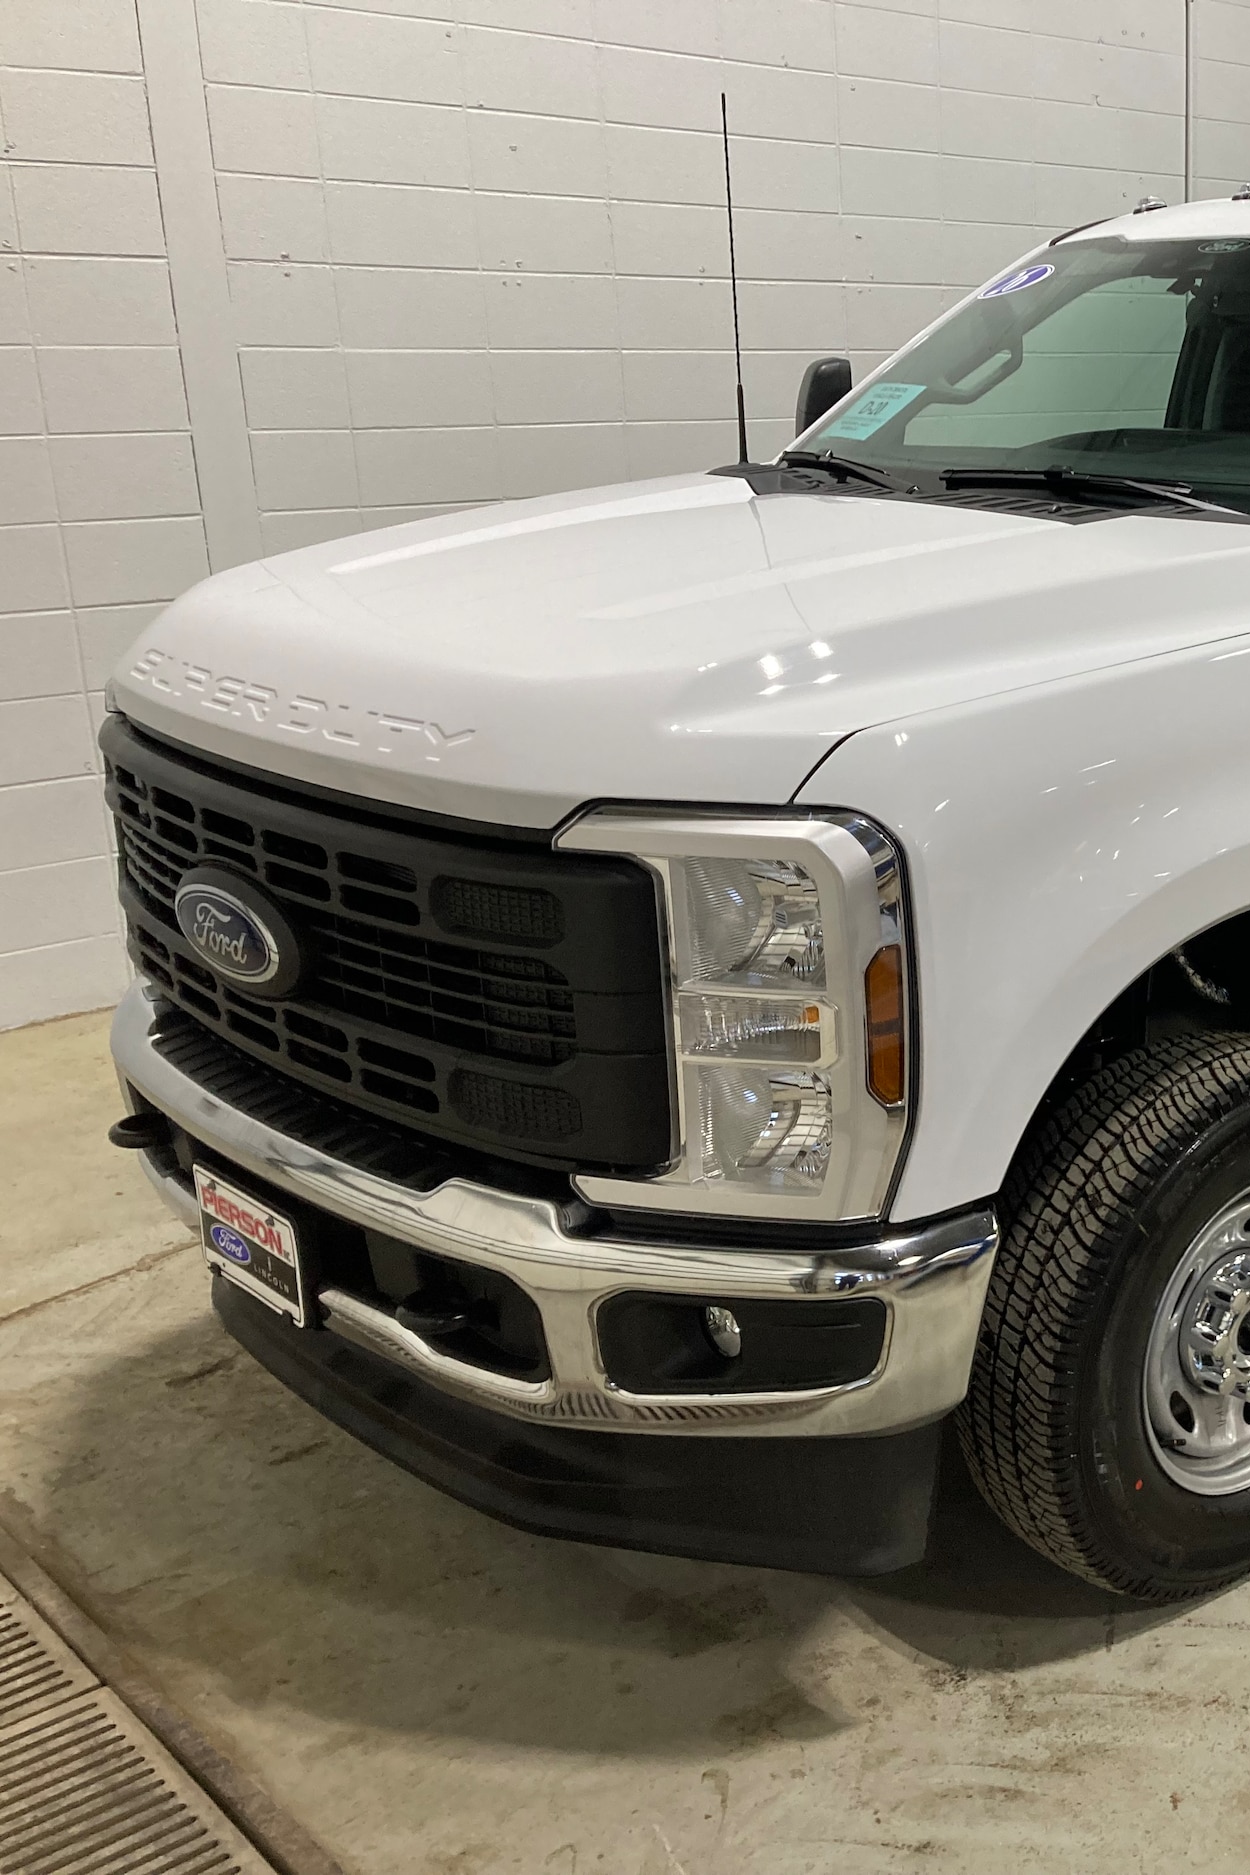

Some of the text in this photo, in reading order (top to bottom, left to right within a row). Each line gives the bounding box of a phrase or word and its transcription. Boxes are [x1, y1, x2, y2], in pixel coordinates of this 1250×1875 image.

[130, 648, 476, 761] SUPER DUTY
[193, 902, 248, 964] Ford
[201, 1185, 283, 1257] PIERSON
[218, 1229, 244, 1258] Ford
[253, 1262, 290, 1294] LINCOLN
